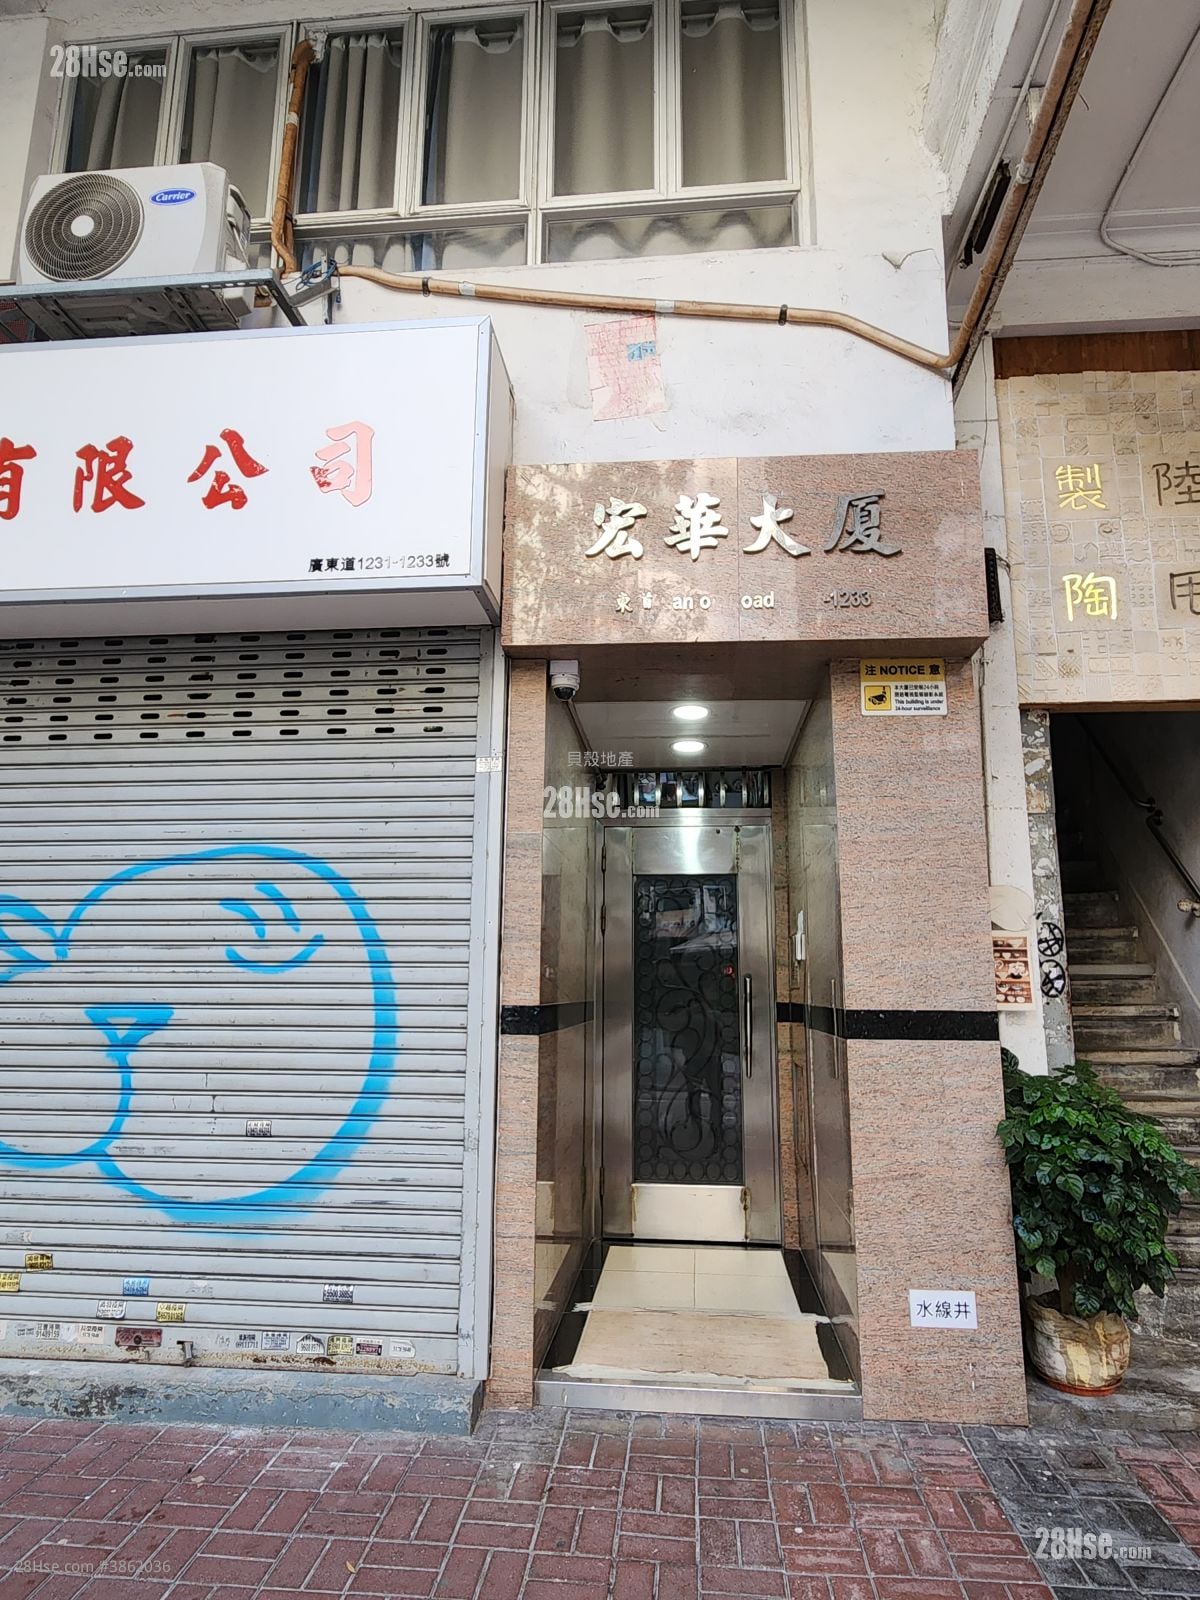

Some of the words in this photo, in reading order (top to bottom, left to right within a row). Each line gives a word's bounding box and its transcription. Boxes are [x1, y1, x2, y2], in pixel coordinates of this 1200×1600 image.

[155, 191, 191, 202] Carrier
[308, 553, 450, 572] 廣東道1231-1233號
[865, 664, 876, 675] 注
[880, 665, 926, 676] NOTICE
[916, 1300, 971, 1320] 水線井
